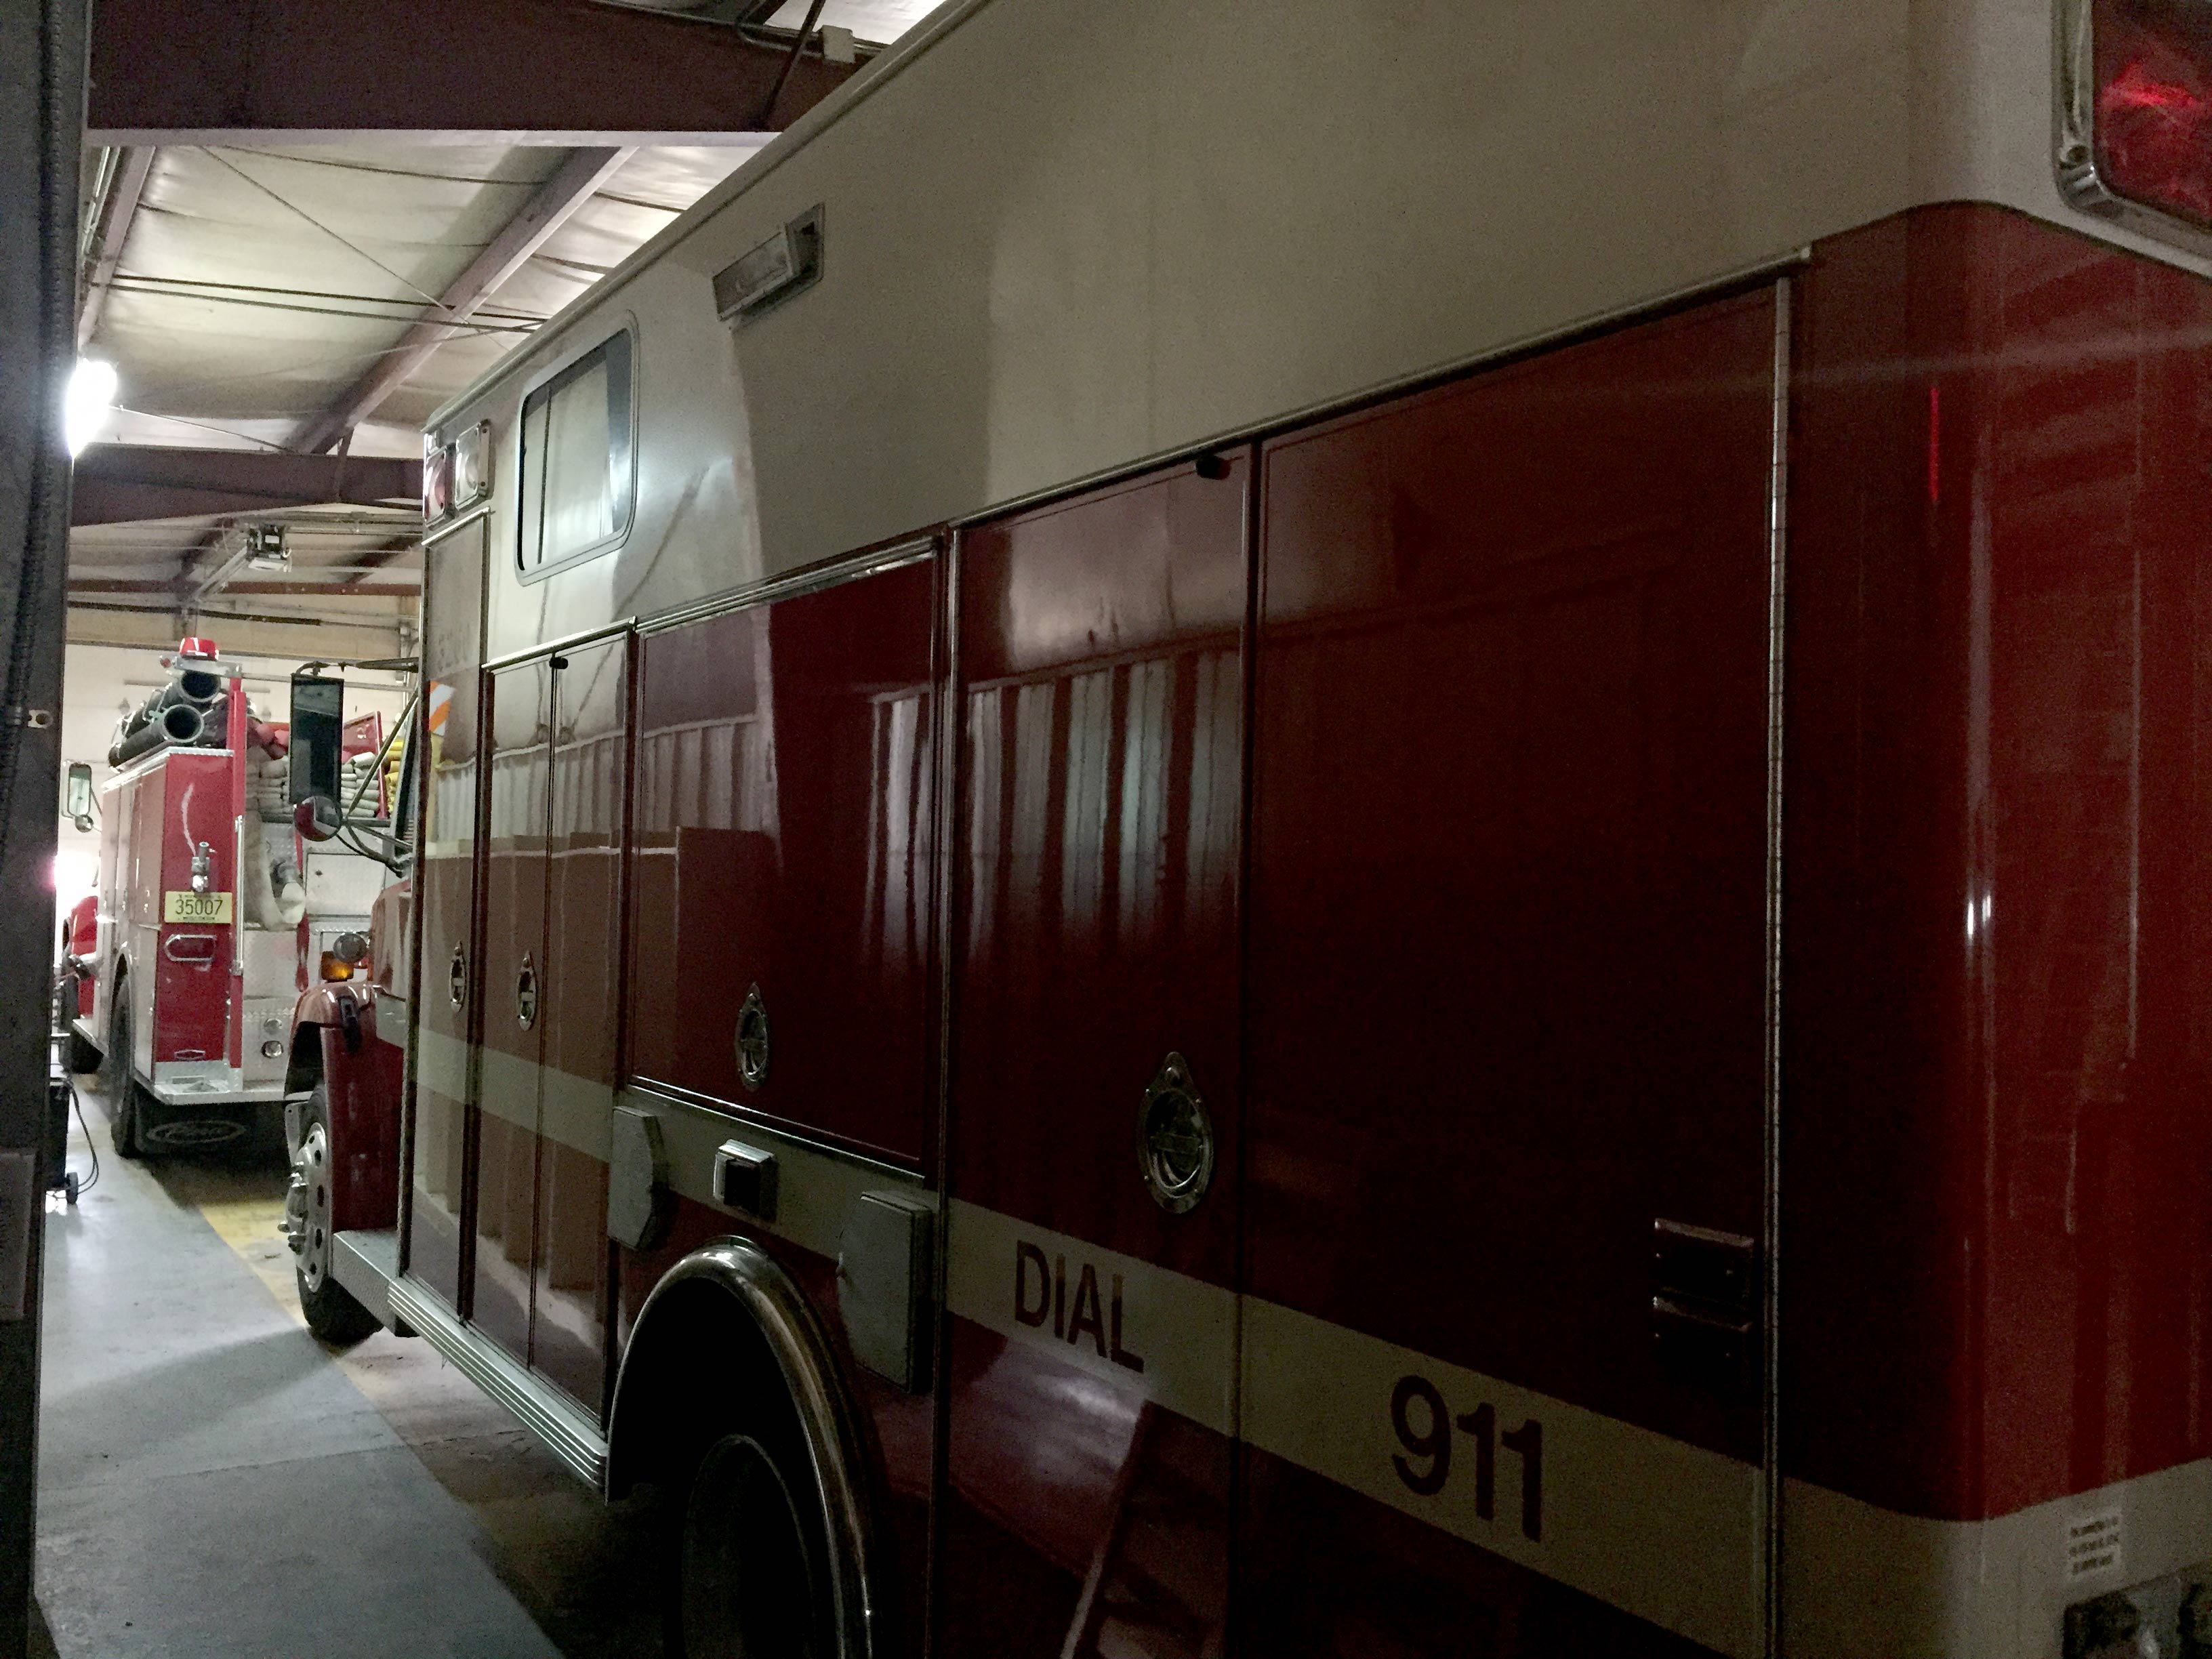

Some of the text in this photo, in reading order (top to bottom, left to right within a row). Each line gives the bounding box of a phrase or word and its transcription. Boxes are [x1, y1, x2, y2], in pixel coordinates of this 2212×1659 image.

[175, 899, 224, 915] 35007
[1015, 1240, 1542, 1543] DIAL 911
